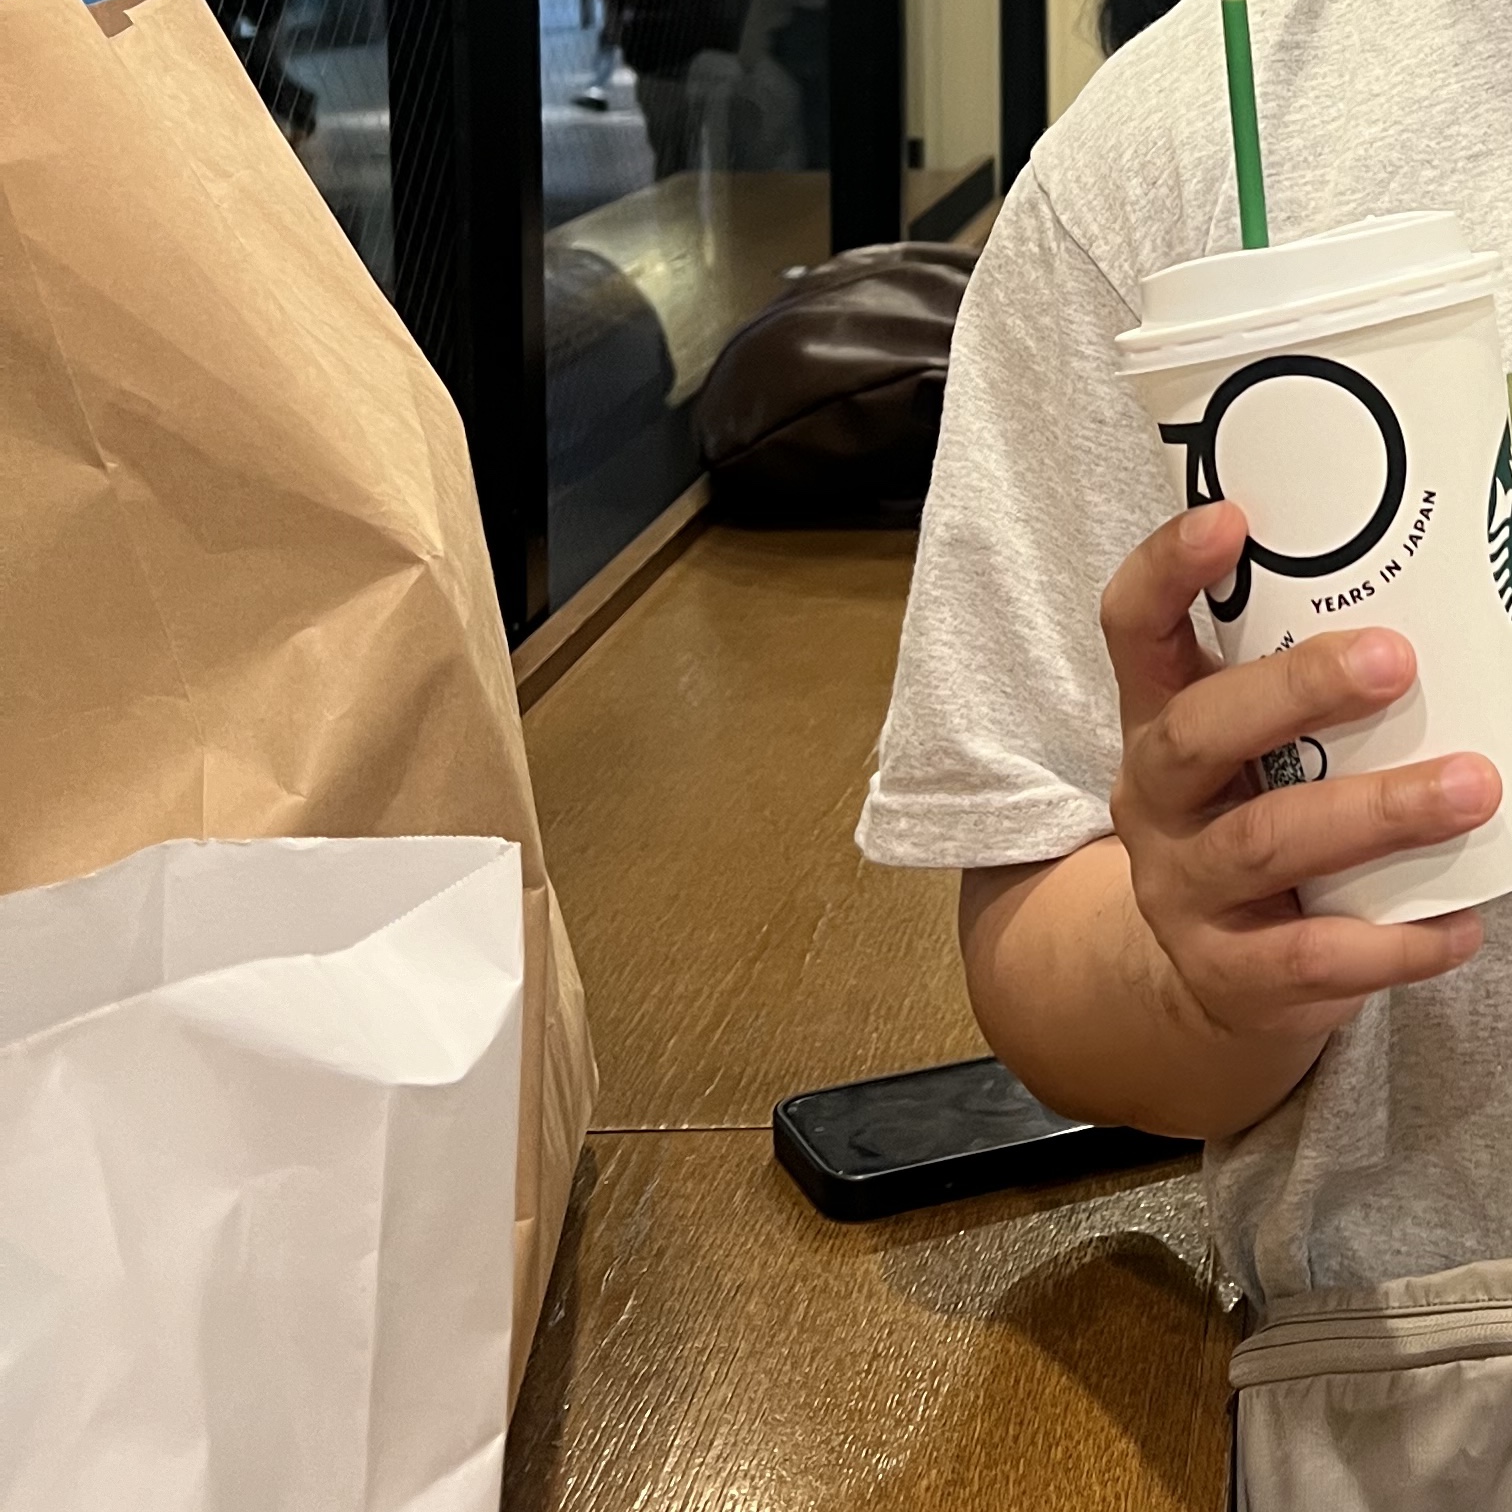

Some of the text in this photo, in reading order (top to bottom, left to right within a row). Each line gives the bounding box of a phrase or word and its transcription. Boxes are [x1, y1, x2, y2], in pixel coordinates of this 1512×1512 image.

[1310, 489, 1437, 614] YEARS IN JAPAN
